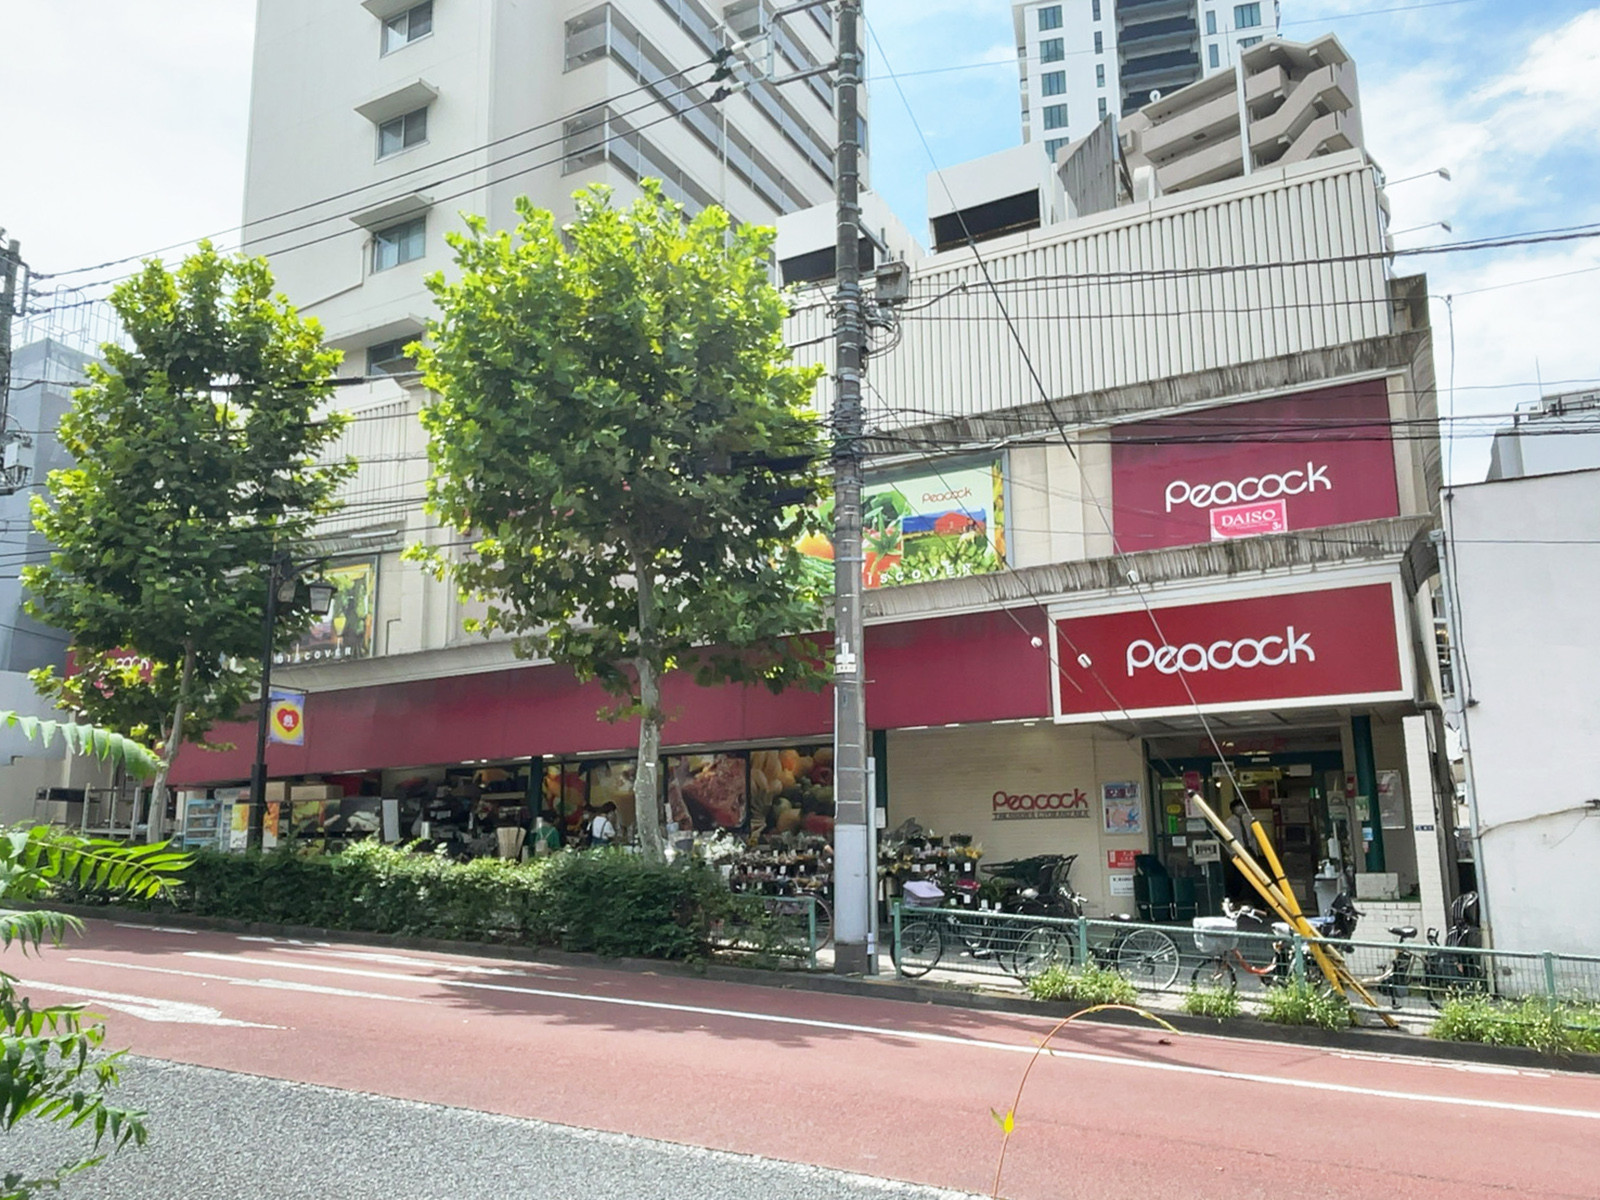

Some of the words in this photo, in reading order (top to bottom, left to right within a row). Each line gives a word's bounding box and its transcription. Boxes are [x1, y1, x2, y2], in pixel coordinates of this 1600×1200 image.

[1165, 461, 1332, 513] Peacock
[1221, 508, 1276, 528] DAISO
[866, 562, 972, 585] ISCOVER
[1126, 625, 1316, 677] Peacock
[992, 788, 1089, 811] Peacock
